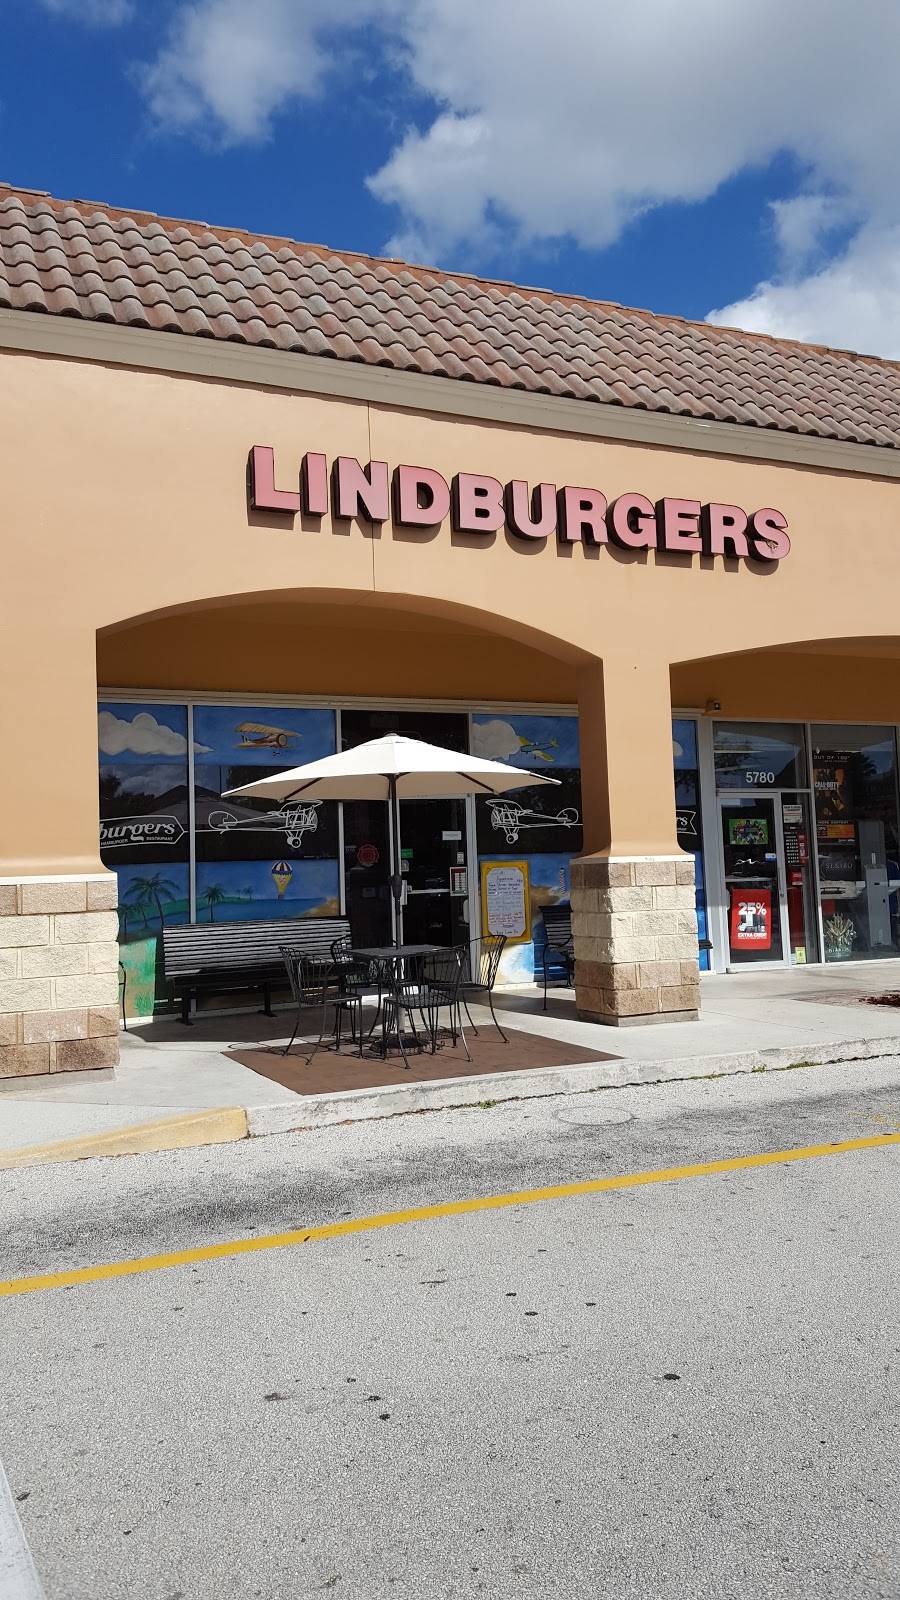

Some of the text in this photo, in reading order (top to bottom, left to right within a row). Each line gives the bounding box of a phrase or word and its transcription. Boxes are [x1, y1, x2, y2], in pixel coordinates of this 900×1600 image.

[249, 445, 791, 560] LINDBURGERS
[745, 771, 775, 784] 5780
[738, 902, 767, 916] 25%
